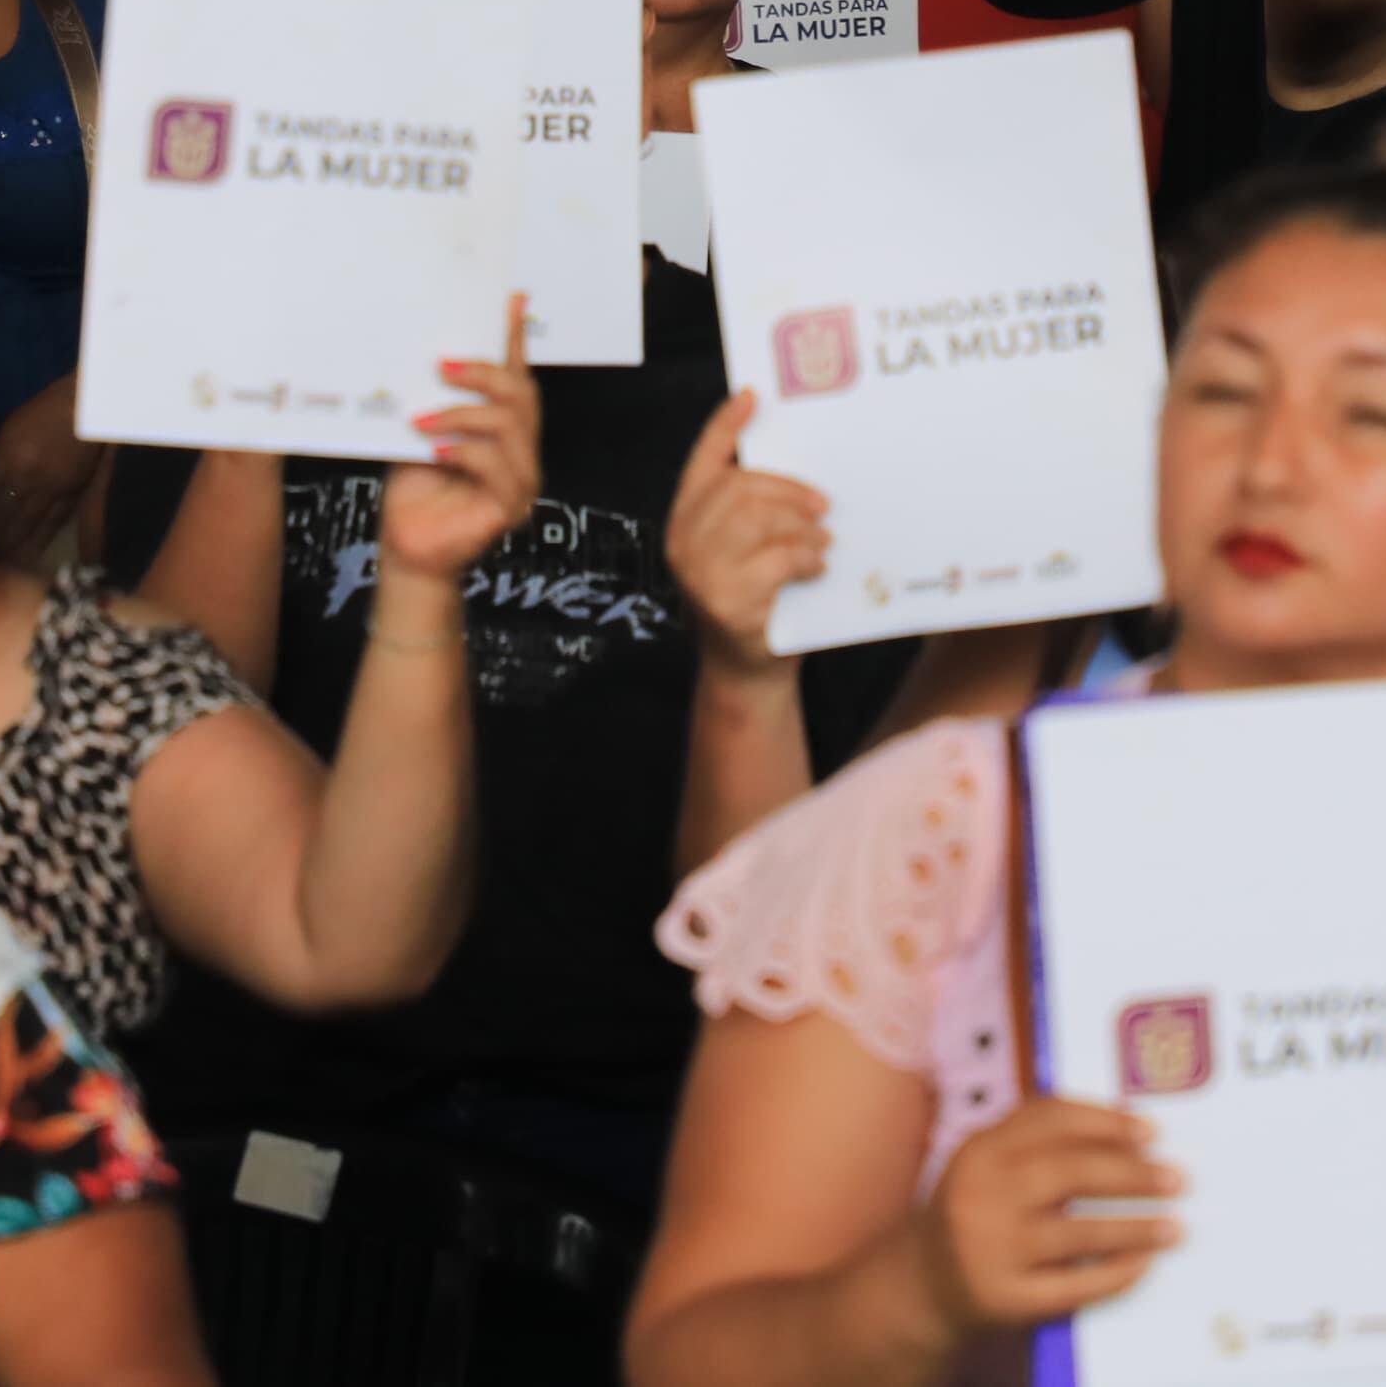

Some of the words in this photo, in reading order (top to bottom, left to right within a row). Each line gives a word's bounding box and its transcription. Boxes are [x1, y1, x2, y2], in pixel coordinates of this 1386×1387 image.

[753, 0, 832, 18] TANDAS
[754, 23, 789, 43] LA
[796, 16, 886, 41] MUJER
[522, 114, 592, 143] JER
[247, 145, 302, 176] LA
[319, 152, 472, 192] MUJER
[874, 337, 936, 376] LA
[947, 313, 1106, 363] MUJER
[1239, 1032, 1312, 1077] LA
